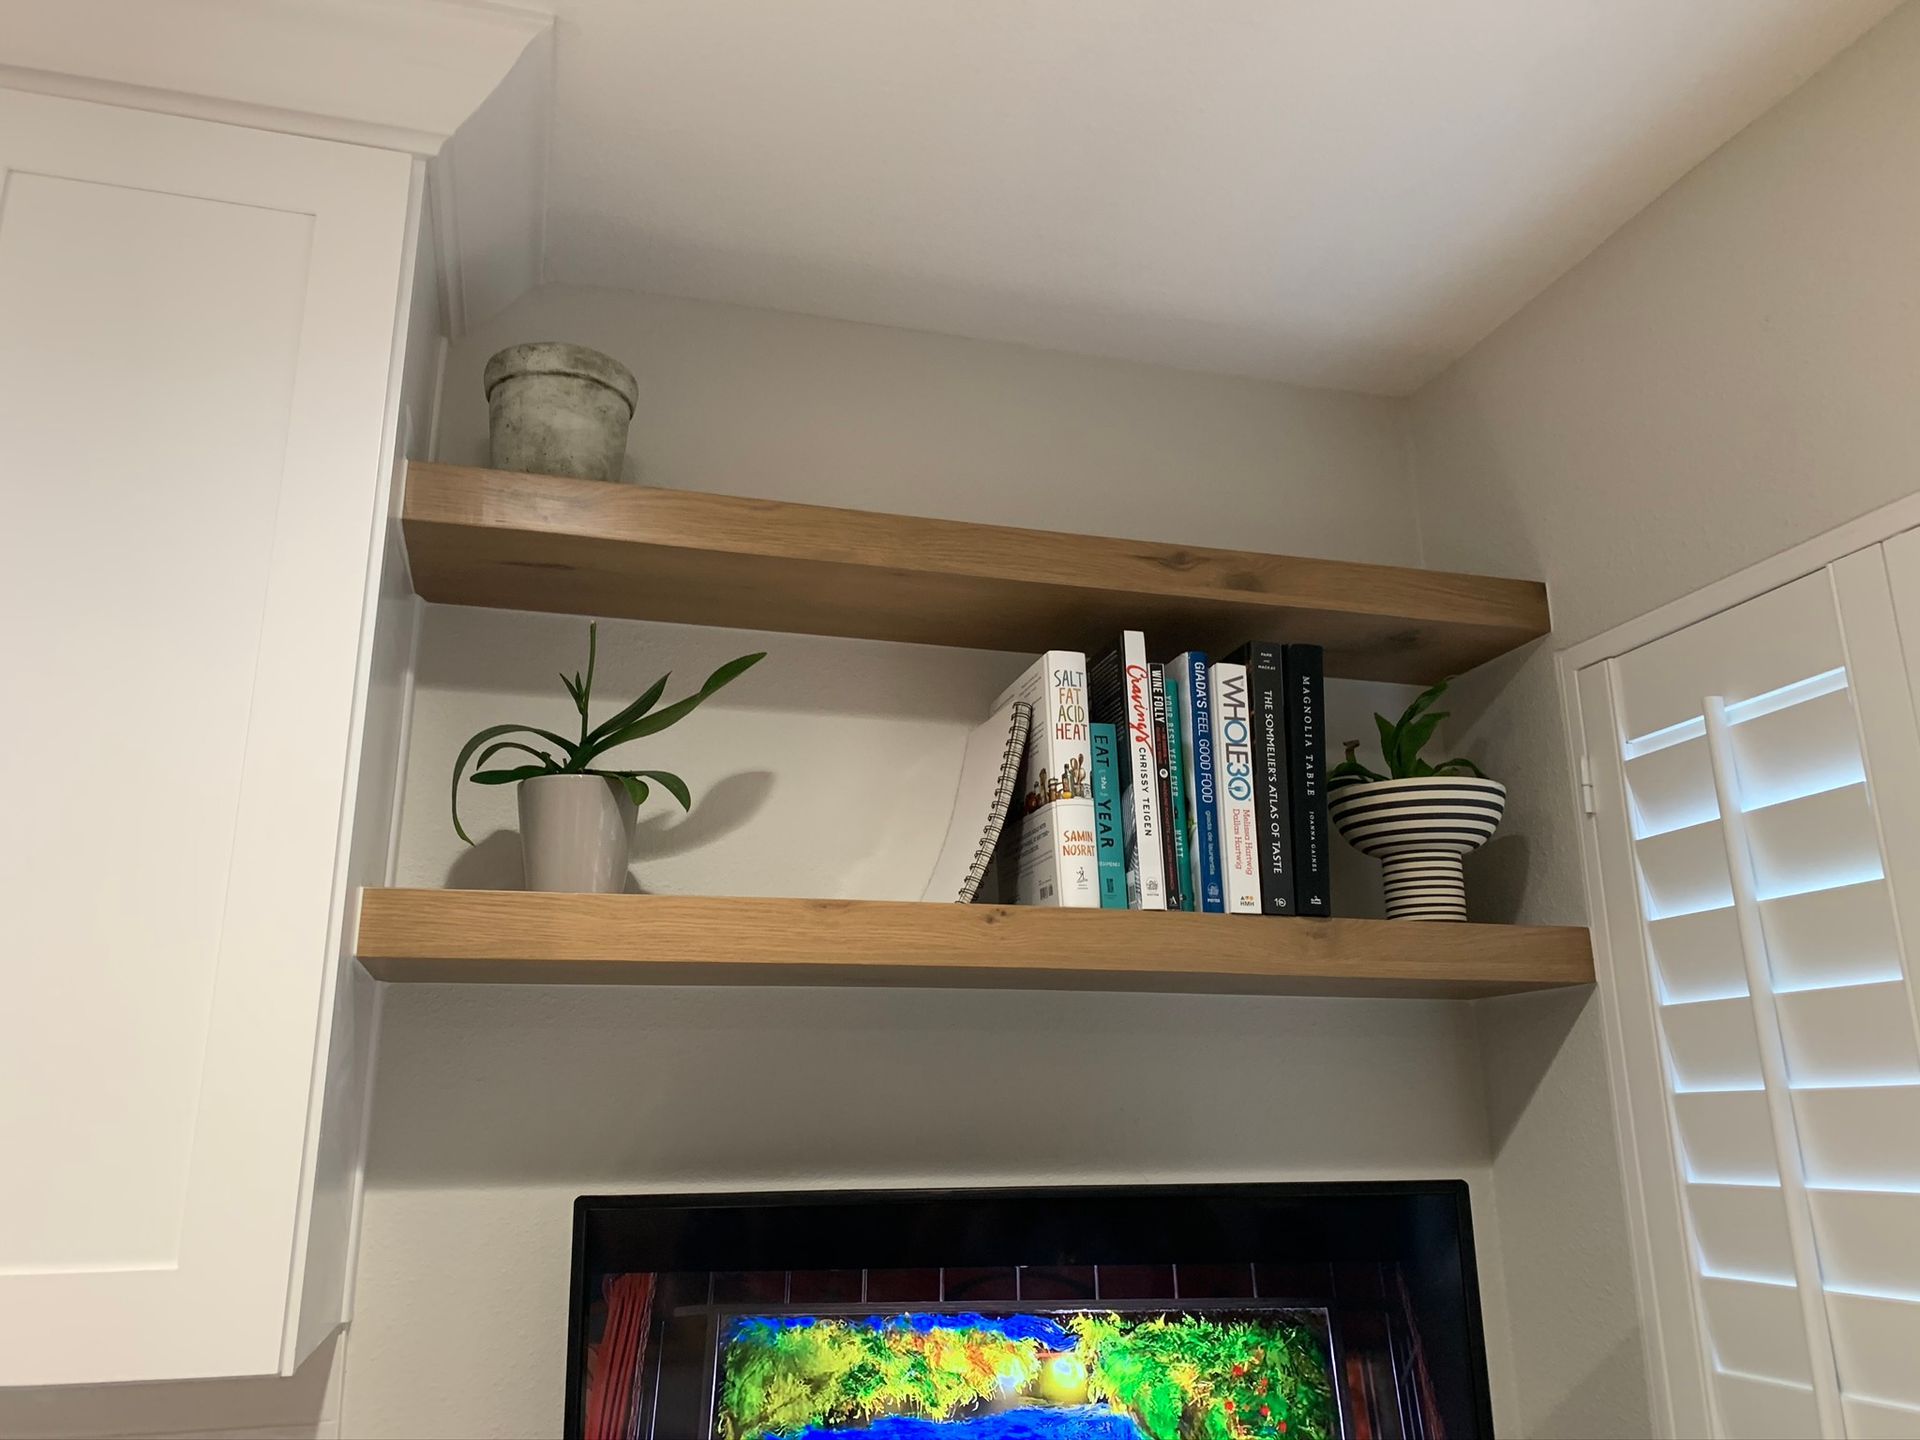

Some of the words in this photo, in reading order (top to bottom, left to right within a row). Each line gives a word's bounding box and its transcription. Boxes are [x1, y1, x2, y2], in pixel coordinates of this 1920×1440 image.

[1054, 669, 1084, 688] SALT
[1151, 669, 1163, 694] WINE
[1194, 661, 1208, 708] GIADA'S
[1059, 687, 1081, 705] FAT
[1126, 665, 1152, 752] Cravings
[1153, 696, 1166, 723] FOLLY
[1264, 690, 1273, 710] THE
[1302, 675, 1312, 747] MAGNOLIA
[1058, 705, 1084, 722] ACID
[1197, 711, 1209, 736] FEEL
[1056, 722, 1087, 741] HEAT
[1265, 713, 1277, 782] SOMMELIER'S
[1094, 735, 1110, 768] EAT
[1198, 738, 1211, 770] GOOD
[1139, 747, 1150, 793] CHRISSY
[1305, 754, 1315, 796] TABLE
[1201, 772, 1213, 804] FOOD
[1268, 784, 1279, 819] ATLAS
[1098, 799, 1115, 848] YEAR
[1142, 798, 1152, 837] TEIGEN
[1232, 808, 1241, 836] Dallas
[1243, 809, 1251, 839] Melissa
[1270, 822, 1280, 838] OF
[1063, 830, 1093, 843] SAMIN
[1063, 845, 1095, 857] NOSRAT
[1234, 836, 1243, 870] Hartwig
[1245, 840, 1253, 876] Hartwig
[1271, 841, 1282, 874] TASTE
